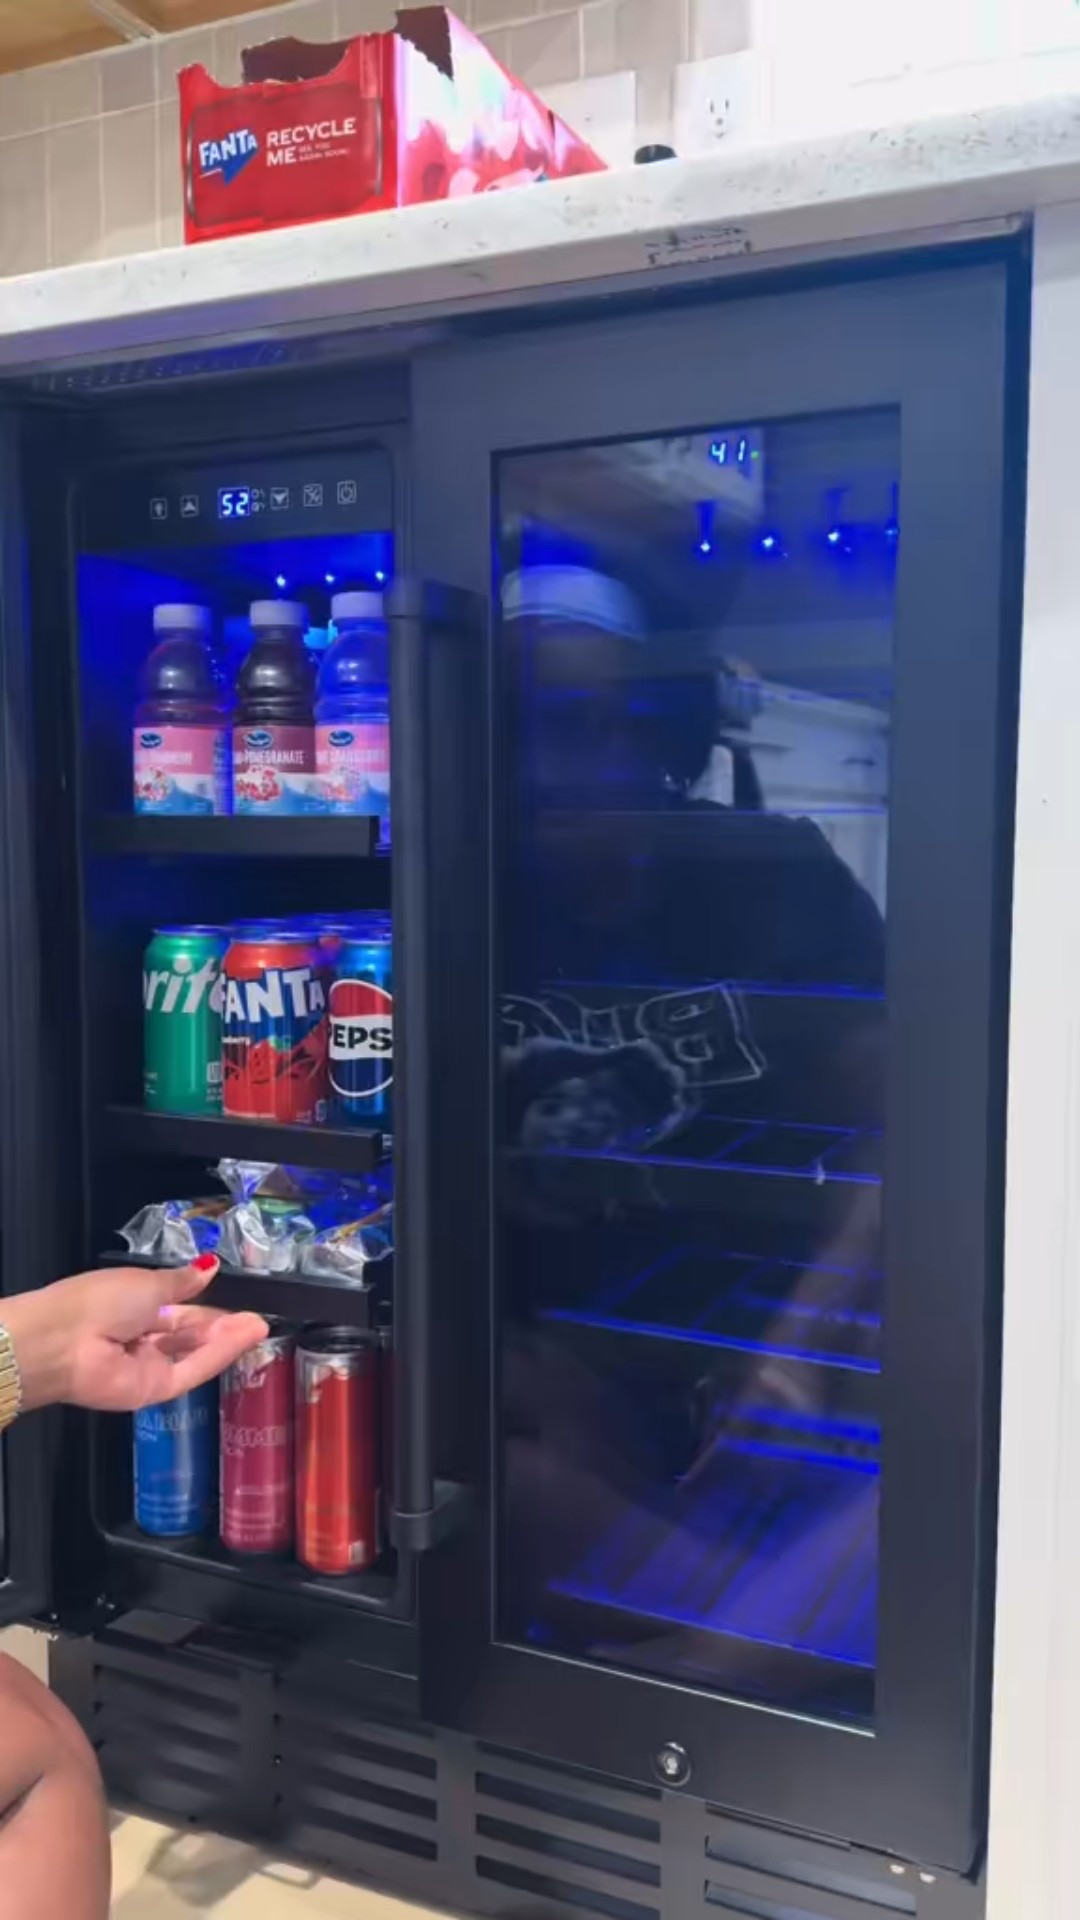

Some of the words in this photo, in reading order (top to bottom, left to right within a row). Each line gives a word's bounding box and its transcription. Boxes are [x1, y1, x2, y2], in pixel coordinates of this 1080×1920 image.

[266, 117, 357, 148] RECYCLE
[199, 129, 258, 166] FANTA
[266, 147, 298, 167] ME
[711, 439, 746, 464] 41
[222, 492, 249, 516] 52
[222, 967, 325, 1024] ANTA
[330, 1022, 393, 1051] EPS
